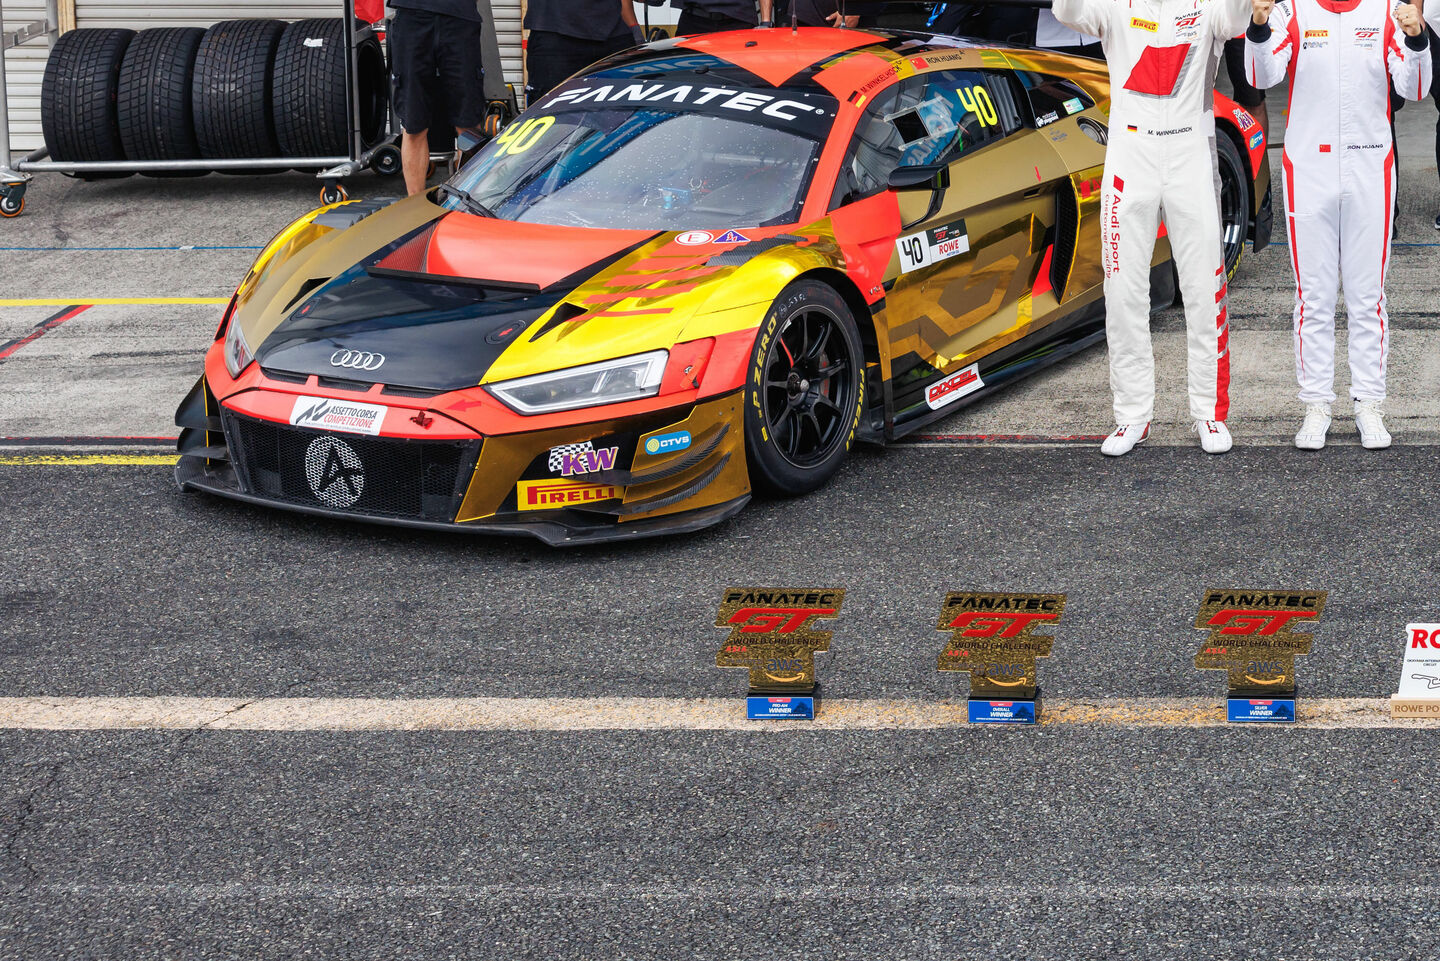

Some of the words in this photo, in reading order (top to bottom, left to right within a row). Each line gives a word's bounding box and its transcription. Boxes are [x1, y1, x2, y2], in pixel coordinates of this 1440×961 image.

[541, 82, 816, 121] FANATEC
[955, 85, 998, 128] 40
[494, 116, 556, 157] 40
[1111, 194, 1121, 228] Audi
[902, 237, 924, 266] 40
[939, 239, 960, 255] ROWE
[1110, 232, 1120, 273] Sport
[753, 312, 778, 386] ZERO
[323, 414, 375, 428] COMPETIZIONE
[329, 406, 357, 417] ASSETTO
[356, 409, 378, 420] CORSA
[561, 446, 619, 477] KW
[527, 484, 615, 506] PIRELLI
[727, 593, 835, 604] FANATEC
[948, 597, 1057, 610] FANATEC
[1207, 594, 1317, 607] FANATEC
[767, 658, 803, 671] aws
[990, 663, 1025, 675] aws
[1247, 661, 1283, 673] aws
[1395, 705, 1423, 713] ROWE
